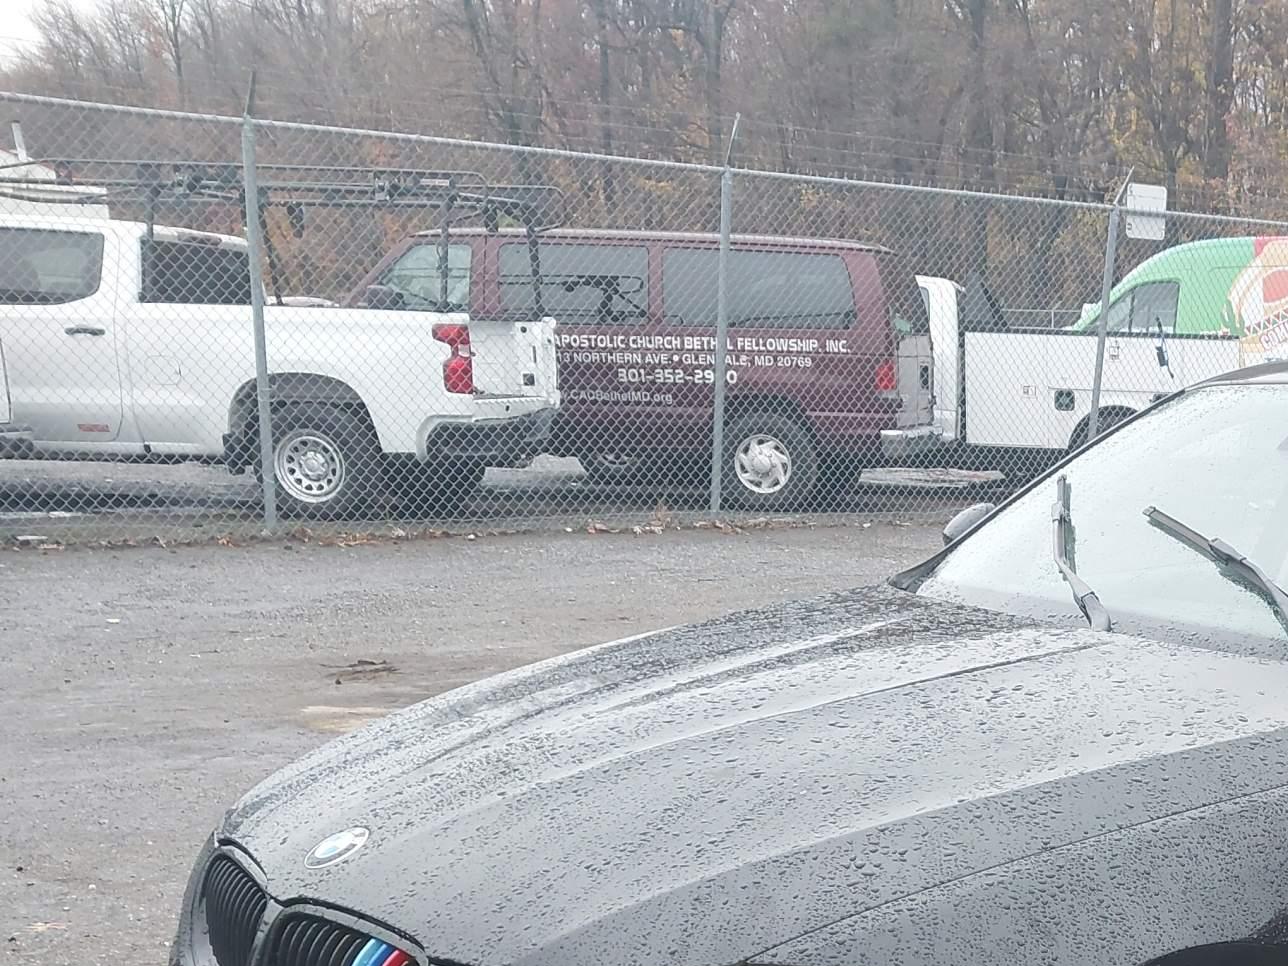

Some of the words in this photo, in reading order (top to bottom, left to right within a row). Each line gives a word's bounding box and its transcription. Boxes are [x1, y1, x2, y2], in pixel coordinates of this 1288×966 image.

[629, 335, 681, 349] CHURCH
[684, 336, 734, 350] BETHL
[573, 352, 641, 363] NORTHERN
[682, 354, 751, 368] GLENALE,
[754, 355, 775, 367] MD
[777, 356, 812, 368] 20769
[617, 367, 738, 385] 301-352-290
